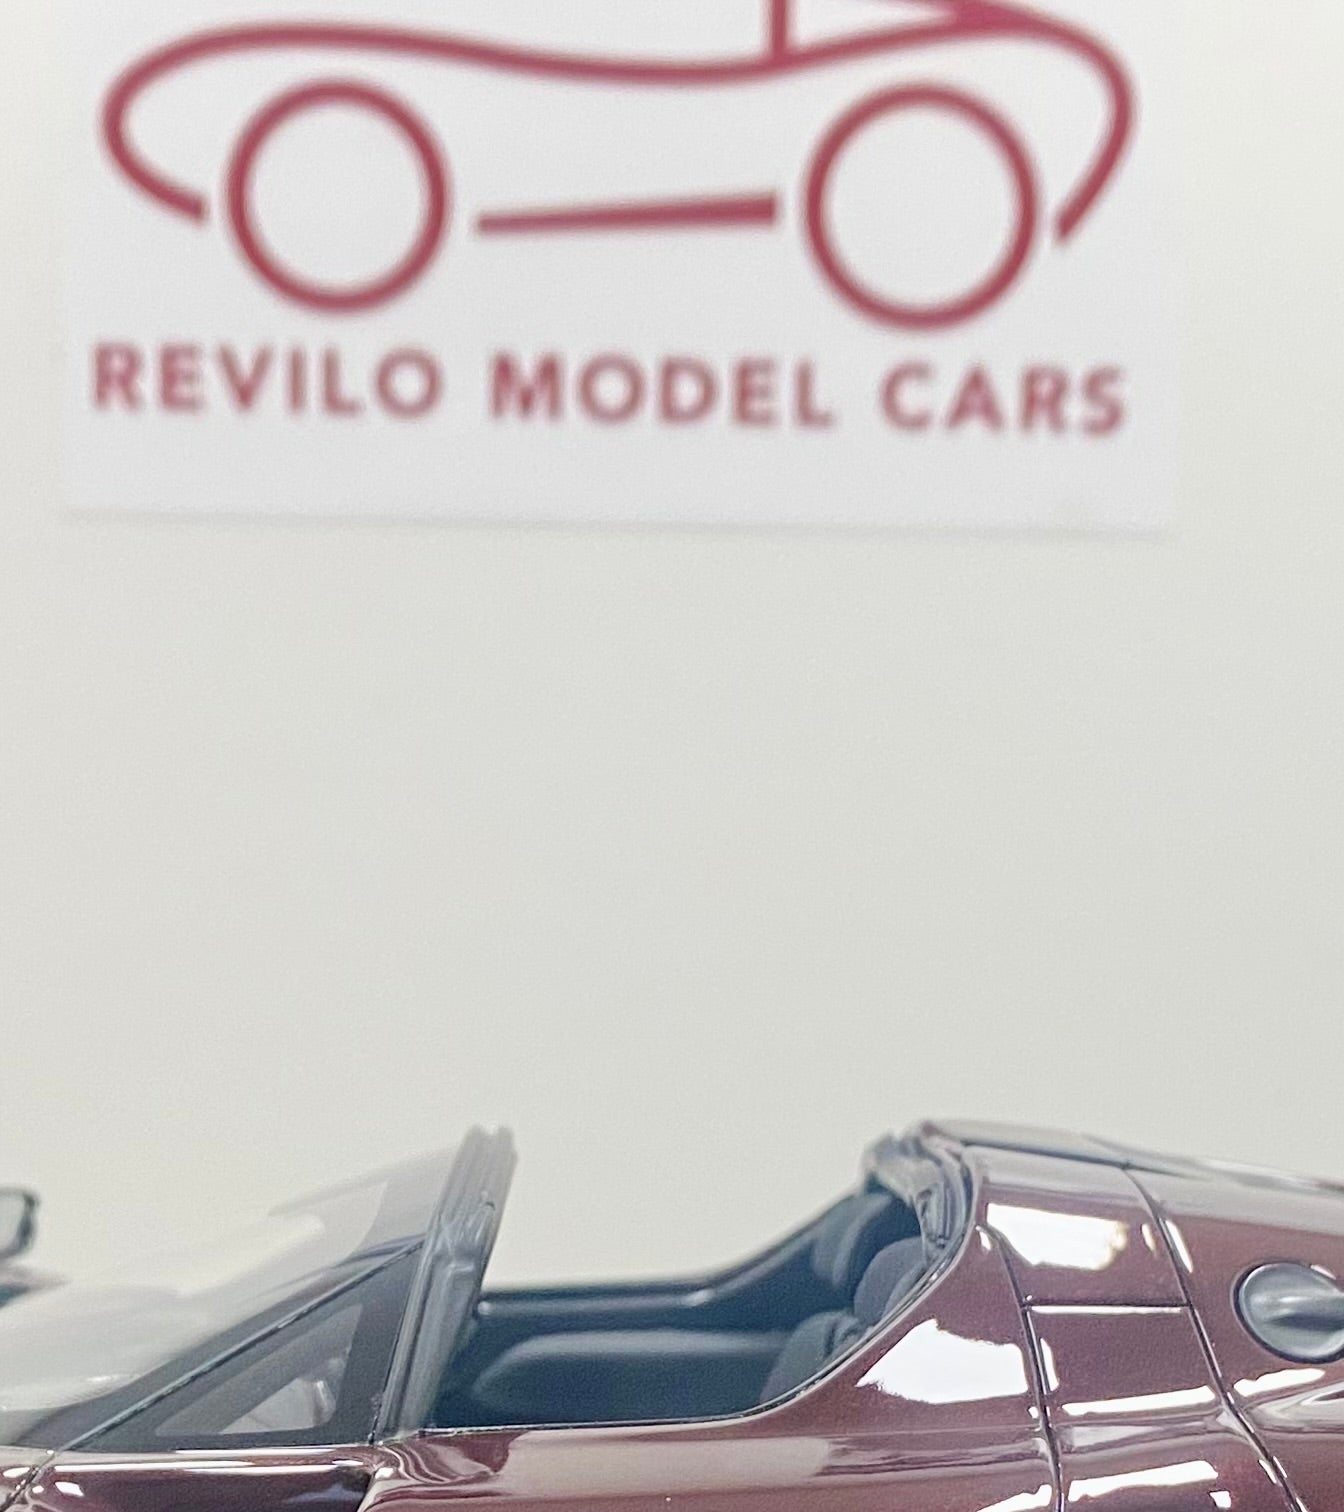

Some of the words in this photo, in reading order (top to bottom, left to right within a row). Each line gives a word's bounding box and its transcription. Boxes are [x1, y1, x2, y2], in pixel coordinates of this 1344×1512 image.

[92, 341, 443, 418] REVILO
[488, 353, 836, 428] MODEL
[879, 364, 1125, 436] CARS
